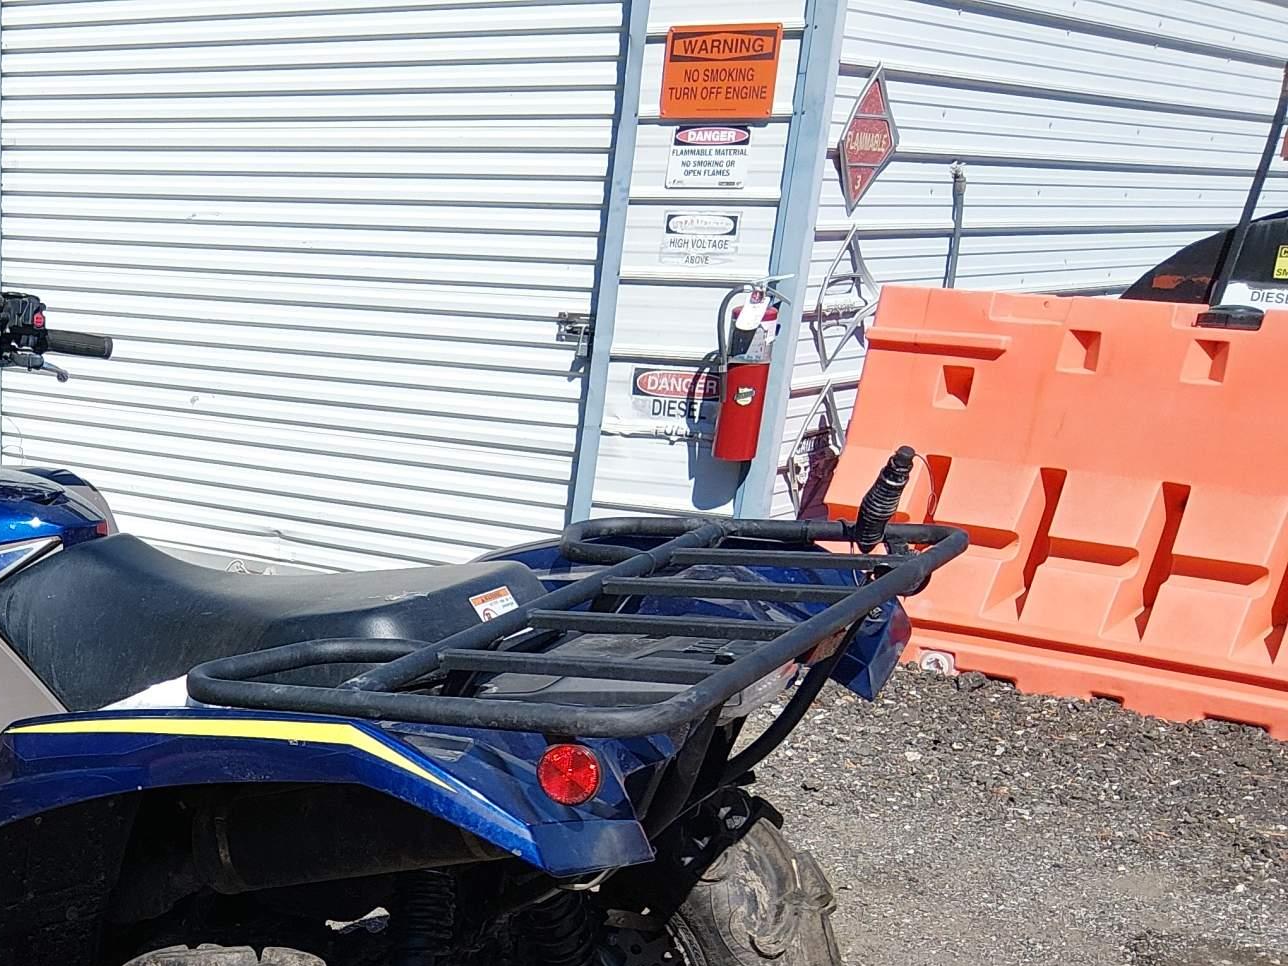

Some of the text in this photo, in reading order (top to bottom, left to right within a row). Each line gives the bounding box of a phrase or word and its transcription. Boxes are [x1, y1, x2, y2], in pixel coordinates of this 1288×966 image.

[683, 38, 764, 54] WARNING
[684, 67, 754, 82] NO SMOKING
[669, 85, 767, 100] TURN OFF ENGINE
[687, 130, 737, 142] DANGER
[845, 131, 888, 152] FLAMMABLE
[672, 148, 748, 157] FLAMMABLE MATERIAL
[681, 160, 736, 168] NO SMOKING OR
[683, 169, 731, 177] OPEN FLAMES
[855, 175, 862, 190] 3
[669, 238, 729, 250] HIGH VOLTAGE
[684, 255, 710, 264] ABOVE
[647, 374, 718, 395] DANGER
[652, 398, 707, 420] DIESEL
